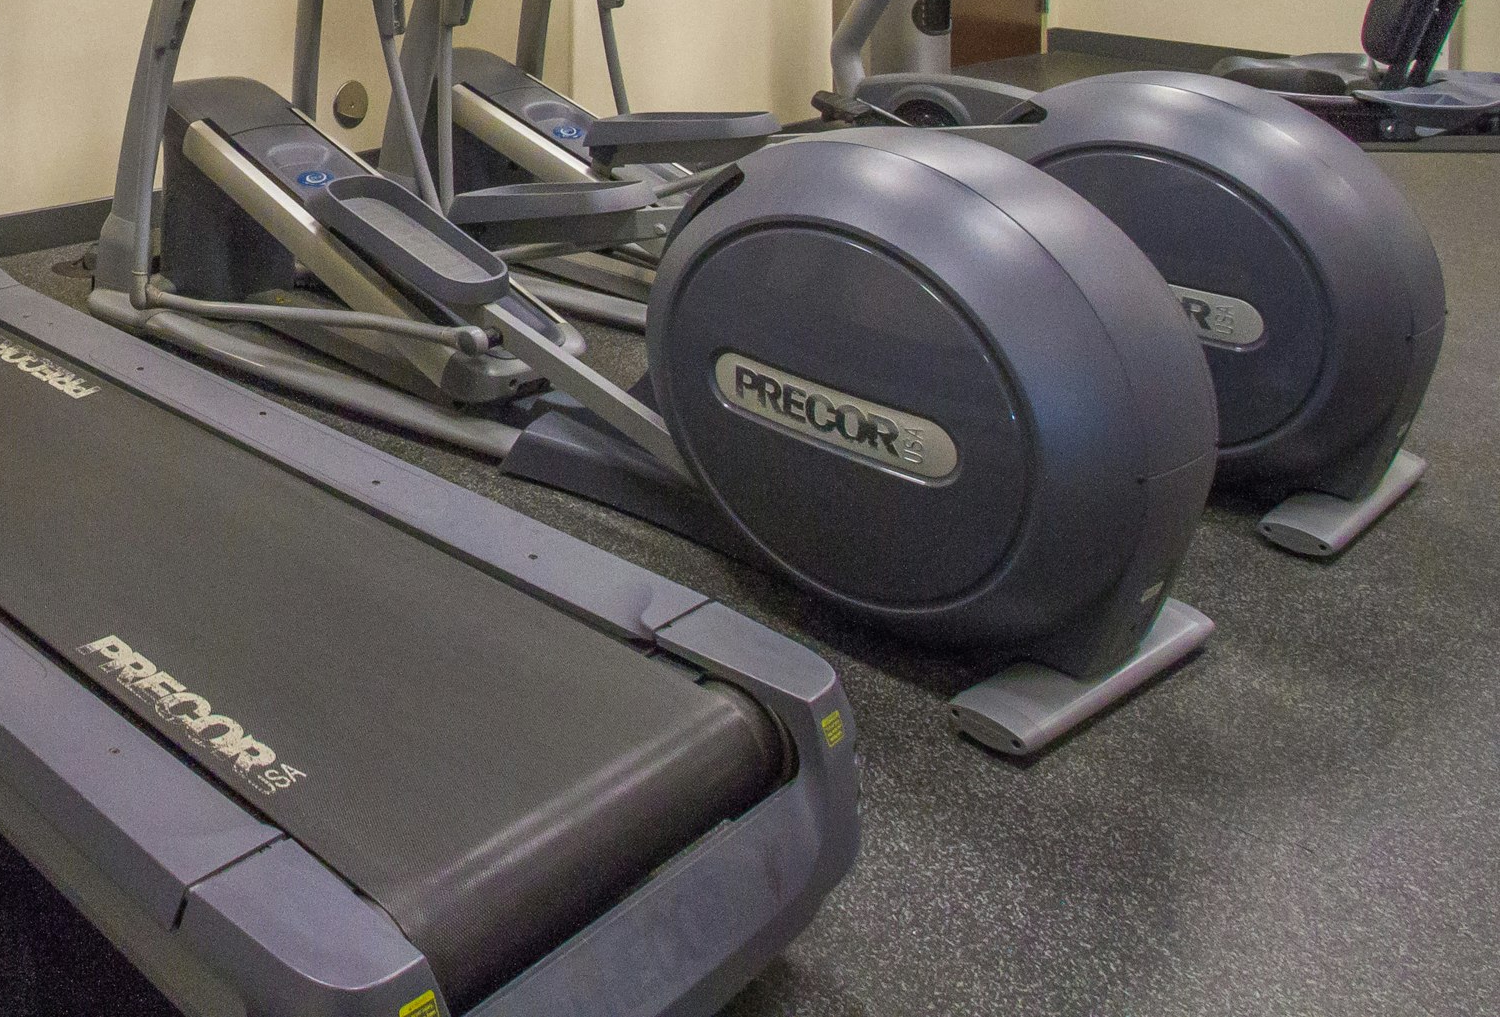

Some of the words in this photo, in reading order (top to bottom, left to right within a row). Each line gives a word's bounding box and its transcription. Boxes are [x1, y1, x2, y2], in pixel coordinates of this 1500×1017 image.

[1214, 304, 1234, 335] USA
[735, 364, 901, 458] PRECOR
[902, 426, 924, 465] USA
[76, 635, 276, 780] PRECOR
